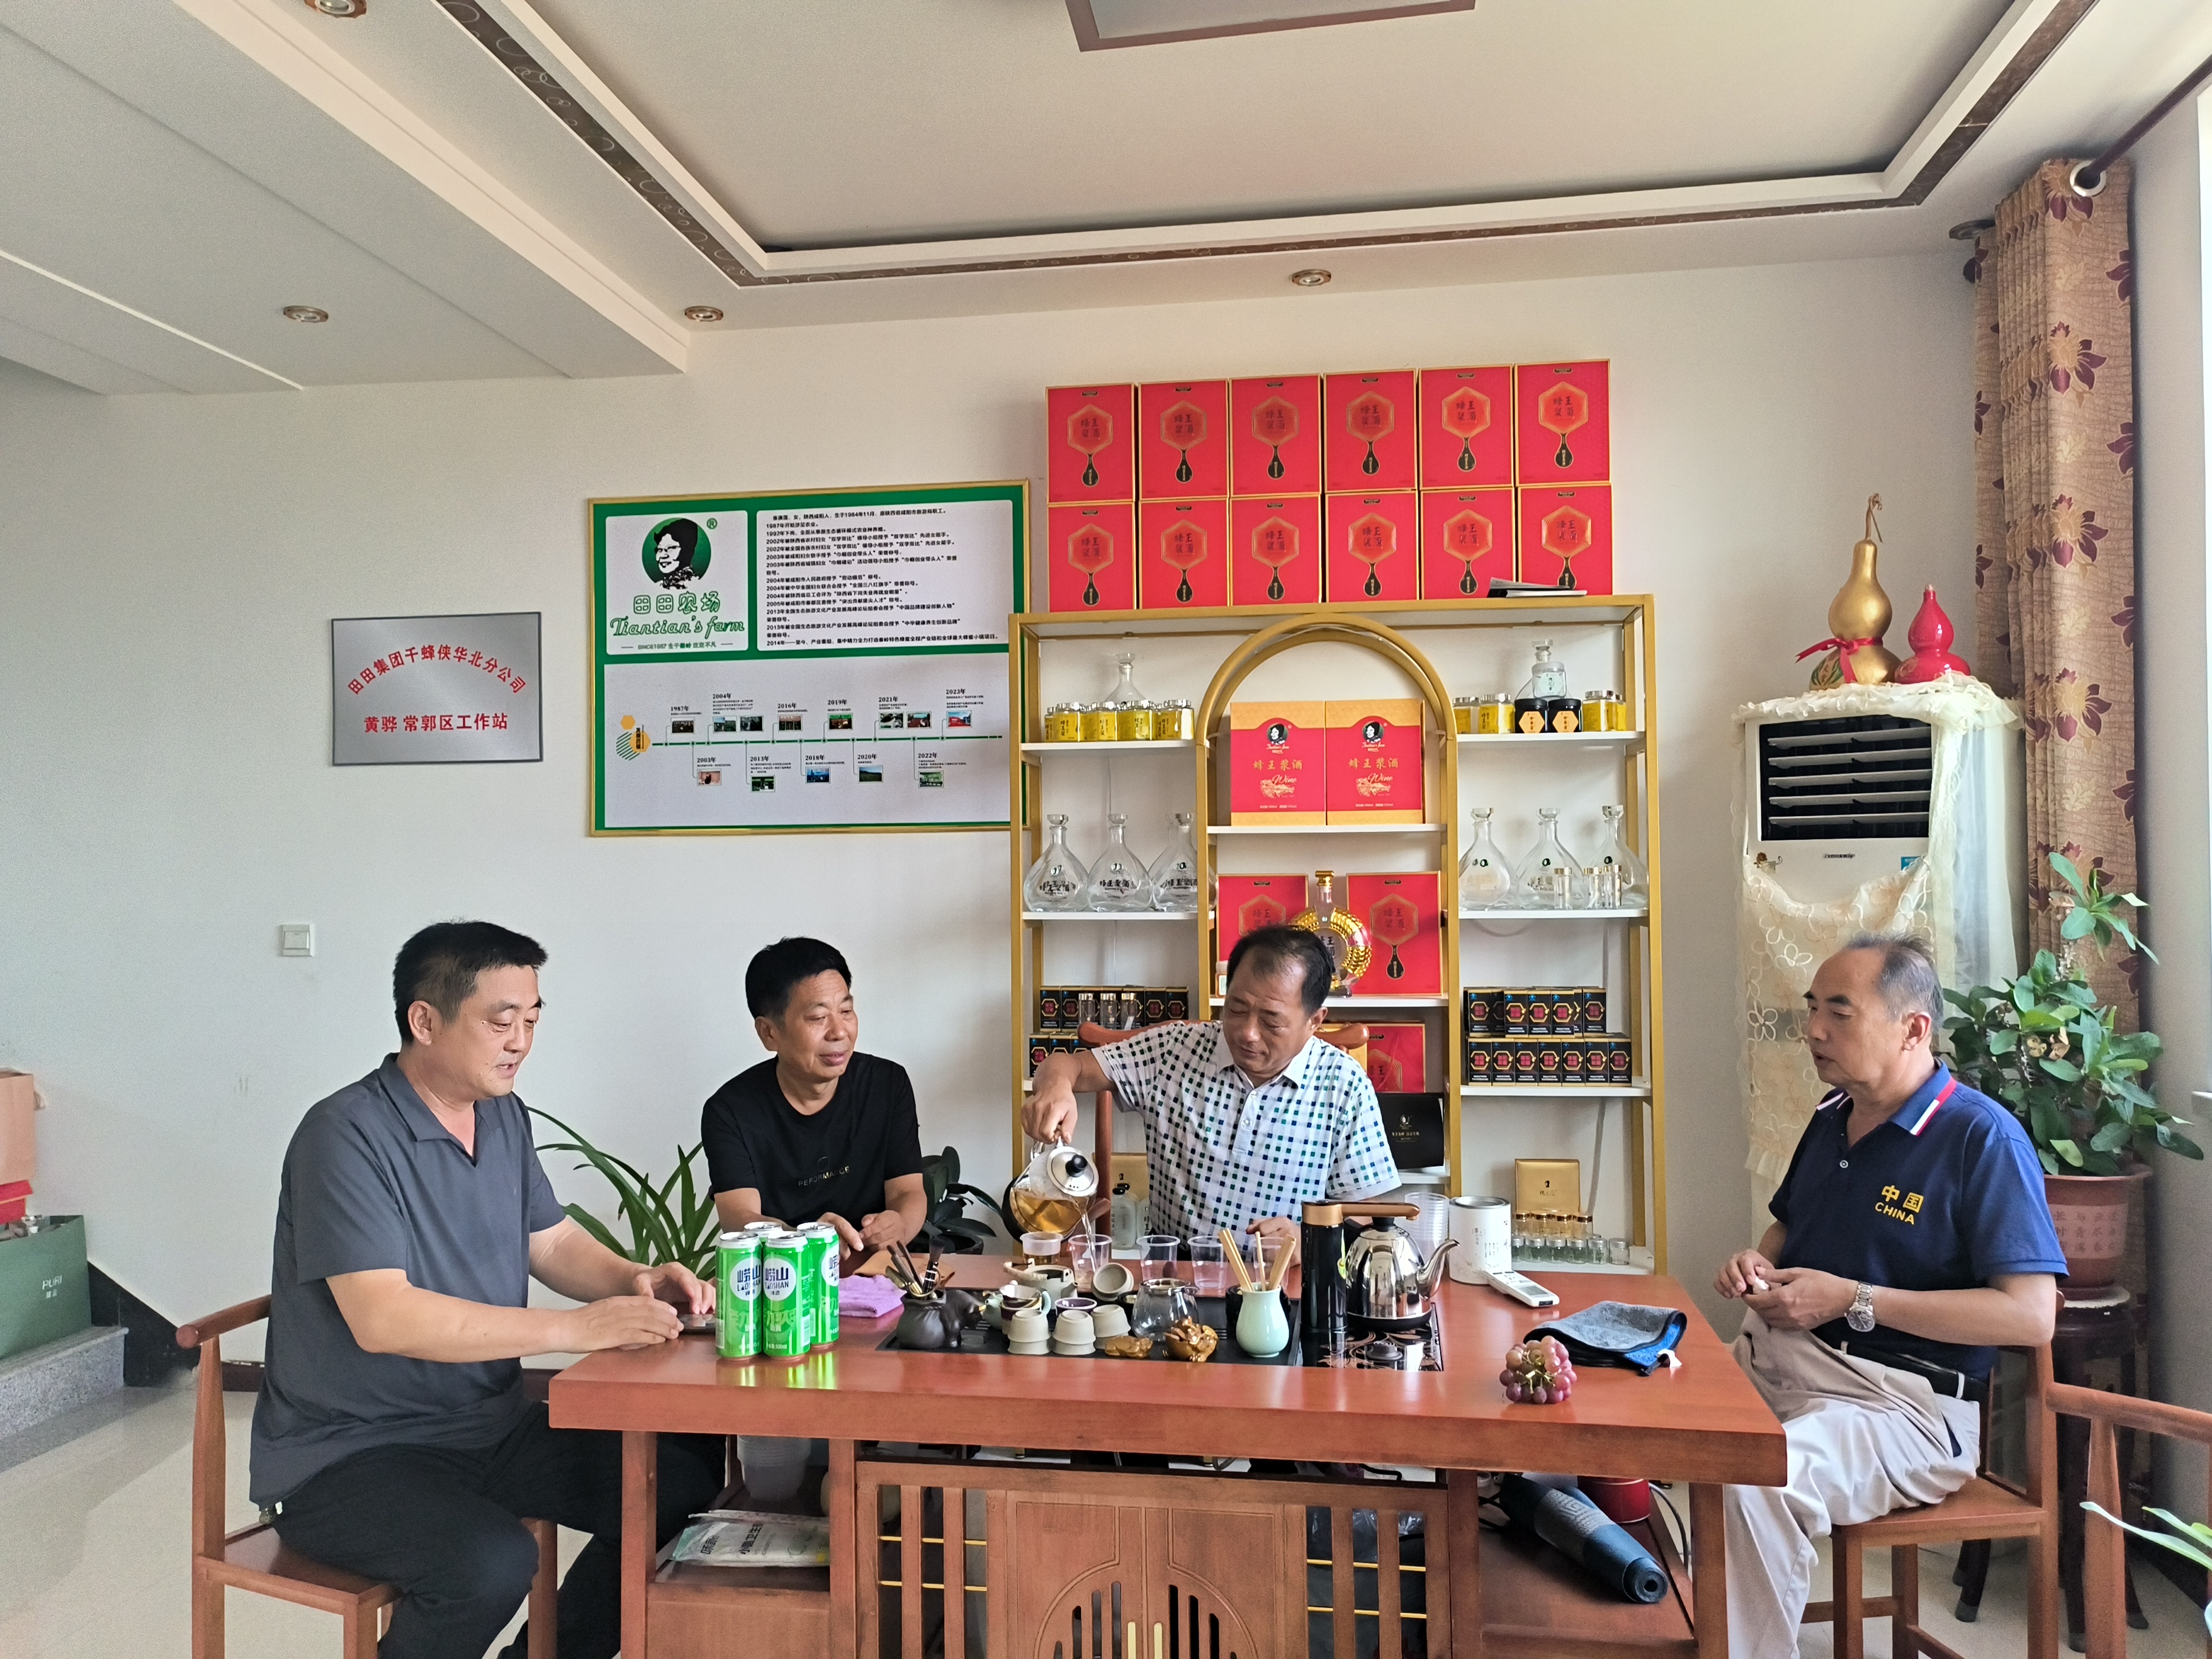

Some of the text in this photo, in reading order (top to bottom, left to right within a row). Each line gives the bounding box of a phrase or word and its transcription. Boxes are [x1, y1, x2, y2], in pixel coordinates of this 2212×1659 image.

[633, 591, 720, 614] 田田农场
[610, 615, 745, 639] Tiantian's farm
[348, 644, 526, 694] 田田集团千蜂侠华北分公司
[365, 712, 508, 733] 黄骅 常郭区工作站
[1253, 759, 1303, 771] 蜂王浆酒
[1348, 757, 1399, 770] 蜂王浆酒
[1272, 774, 1297, 784] Wine
[1367, 773, 1393, 783] Wine
[1881, 1185, 1924, 1213] 中国
[1874, 1202, 1915, 1225] CHINA
[738, 1265, 761, 1283] 崂山
[765, 1267, 788, 1281] 崂山
[765, 1281, 789, 1290] LAOSHAN
